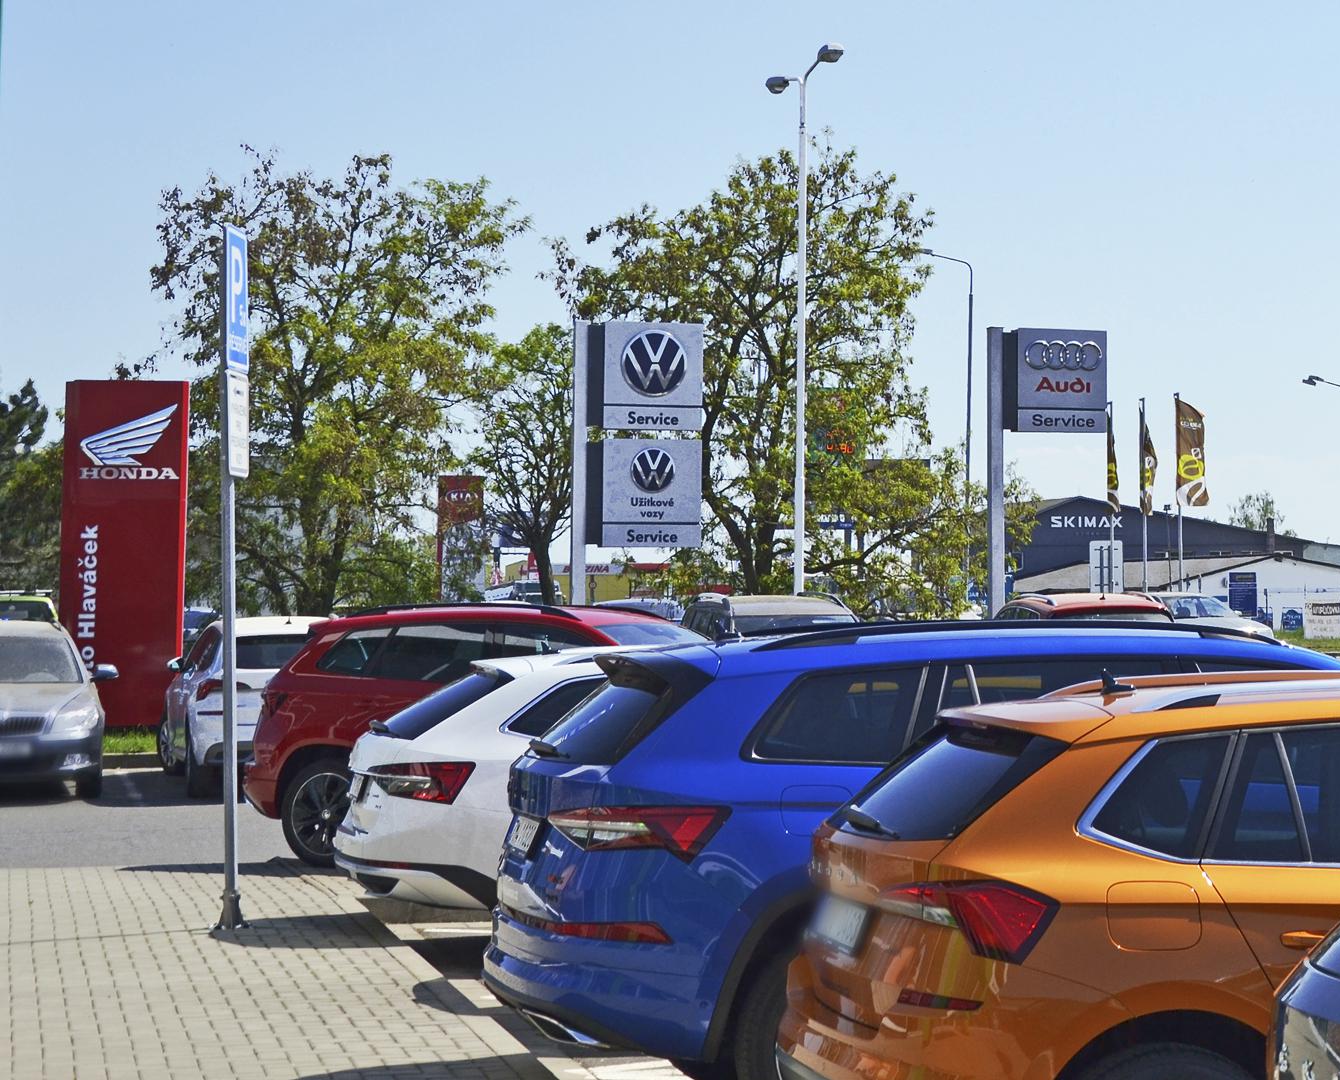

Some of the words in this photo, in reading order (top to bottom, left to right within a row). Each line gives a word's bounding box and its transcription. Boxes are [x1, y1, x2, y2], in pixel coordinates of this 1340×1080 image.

[231, 245, 243, 323] P
[1035, 376, 1091, 394] Audi
[628, 411, 679, 425] Service
[1032, 414, 1095, 428] Service
[79, 467, 179, 480] HONDA
[640, 511, 664, 519] vozy
[1050, 516, 1123, 529] SKIMAX
[626, 529, 678, 543] Service
[562, 563, 610, 574] BZINA
[77, 525, 99, 638] Hlaváček
[81, 646, 95, 670] to
